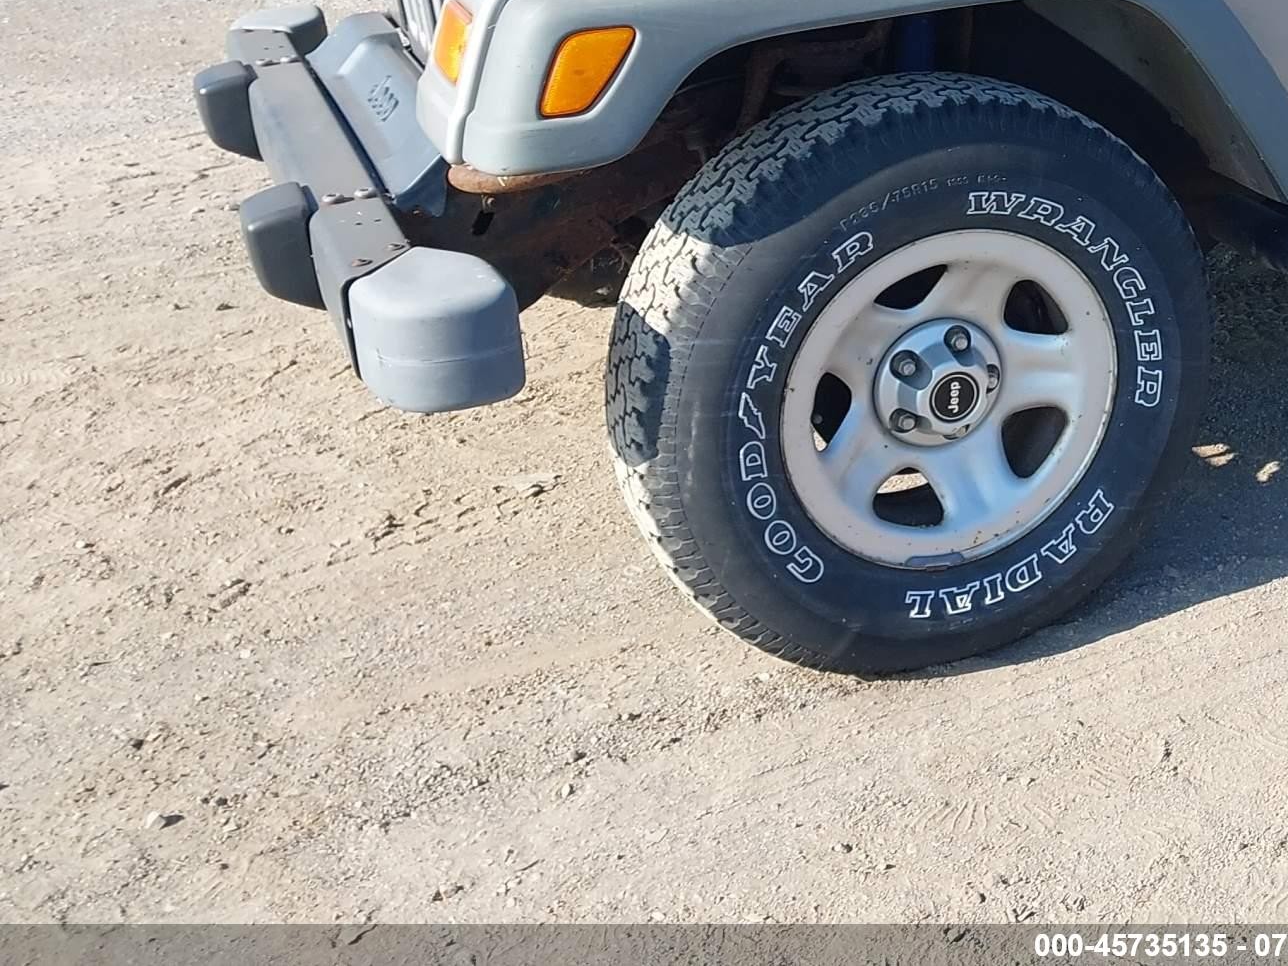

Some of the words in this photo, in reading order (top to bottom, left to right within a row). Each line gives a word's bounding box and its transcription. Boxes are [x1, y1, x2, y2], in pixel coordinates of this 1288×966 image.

[966, 190, 1164, 409] WRANGLER
[947, 381, 962, 414] Jeep
[904, 487, 1116, 619] RADIAL
